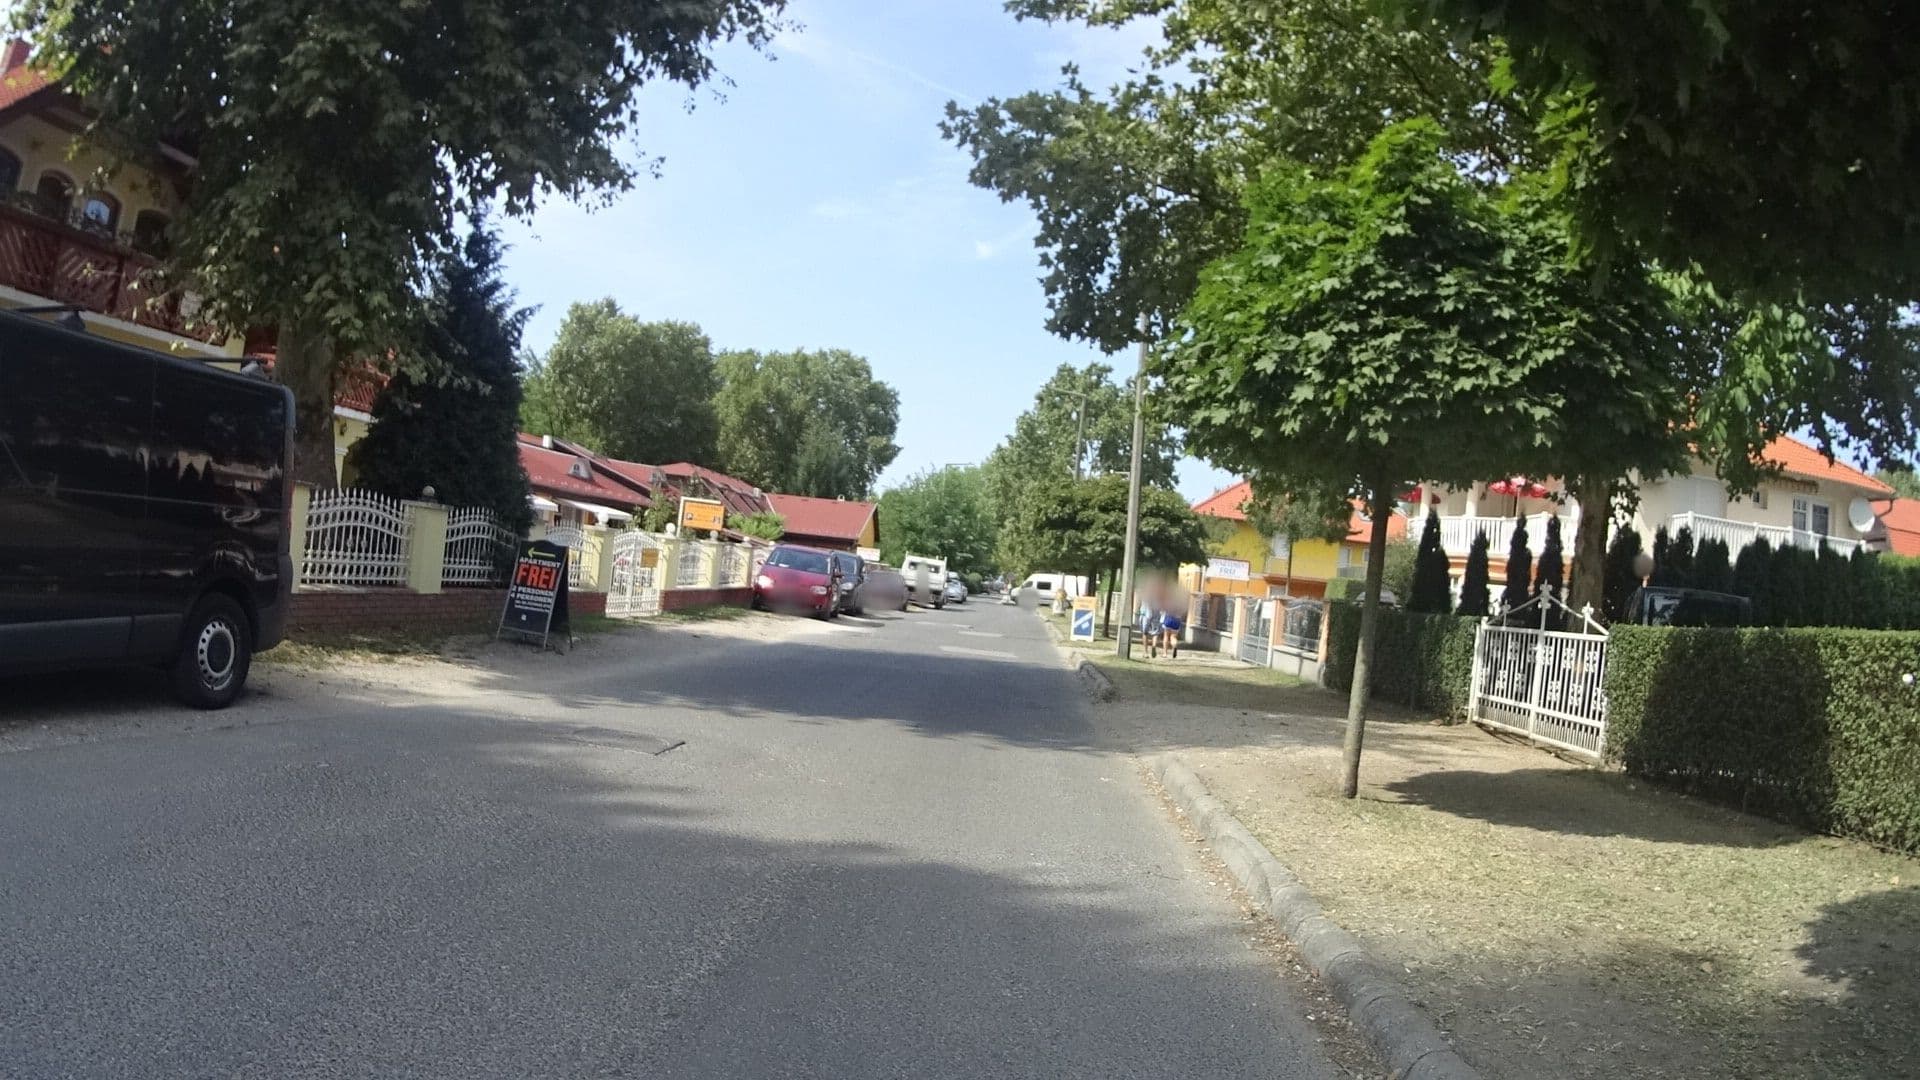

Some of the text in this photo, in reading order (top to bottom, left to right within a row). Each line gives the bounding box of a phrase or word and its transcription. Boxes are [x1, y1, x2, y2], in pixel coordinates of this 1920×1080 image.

[519, 557, 561, 568] APARTMENT
[516, 564, 557, 589] FREI
[518, 586, 554, 596] PERSONEN
[516, 592, 553, 602] PERSONEN
